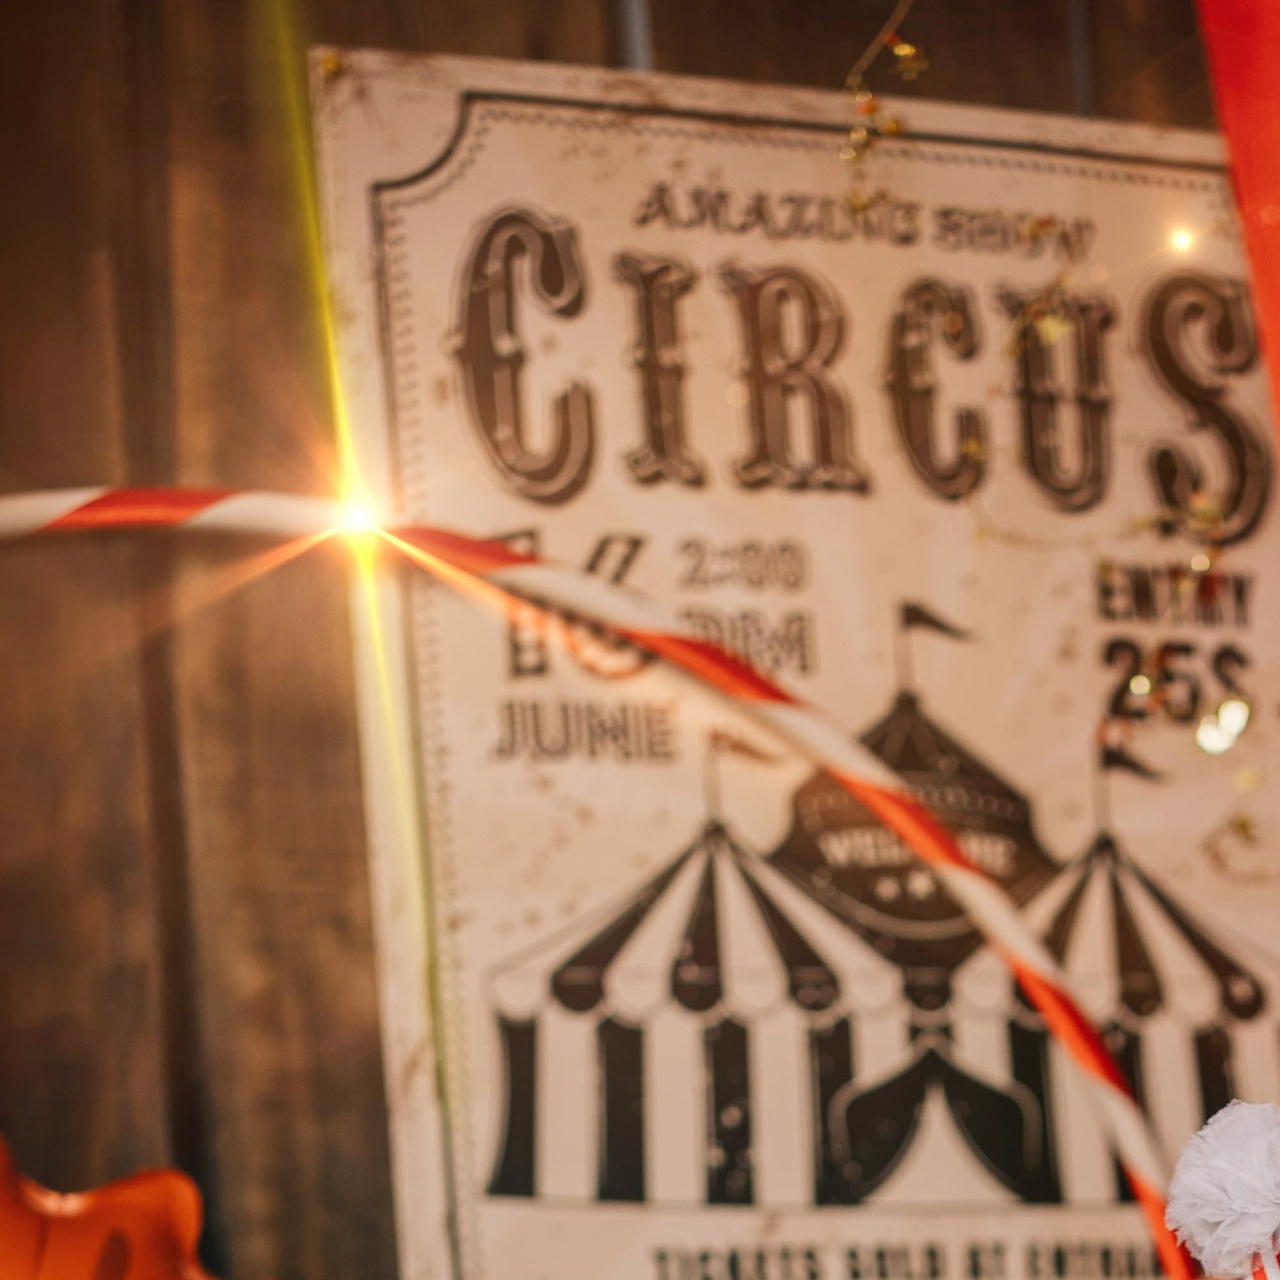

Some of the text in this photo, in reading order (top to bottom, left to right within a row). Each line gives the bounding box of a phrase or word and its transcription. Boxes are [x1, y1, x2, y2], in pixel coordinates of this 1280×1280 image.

[630, 178, 1098, 264] AMAZING SHOW
[446, 204, 1276, 549] CIRCUS
[674, 534, 811, 592] 2:00
[1096, 561, 1256, 629] ENTRY
[492, 698, 679, 763] JUNE
